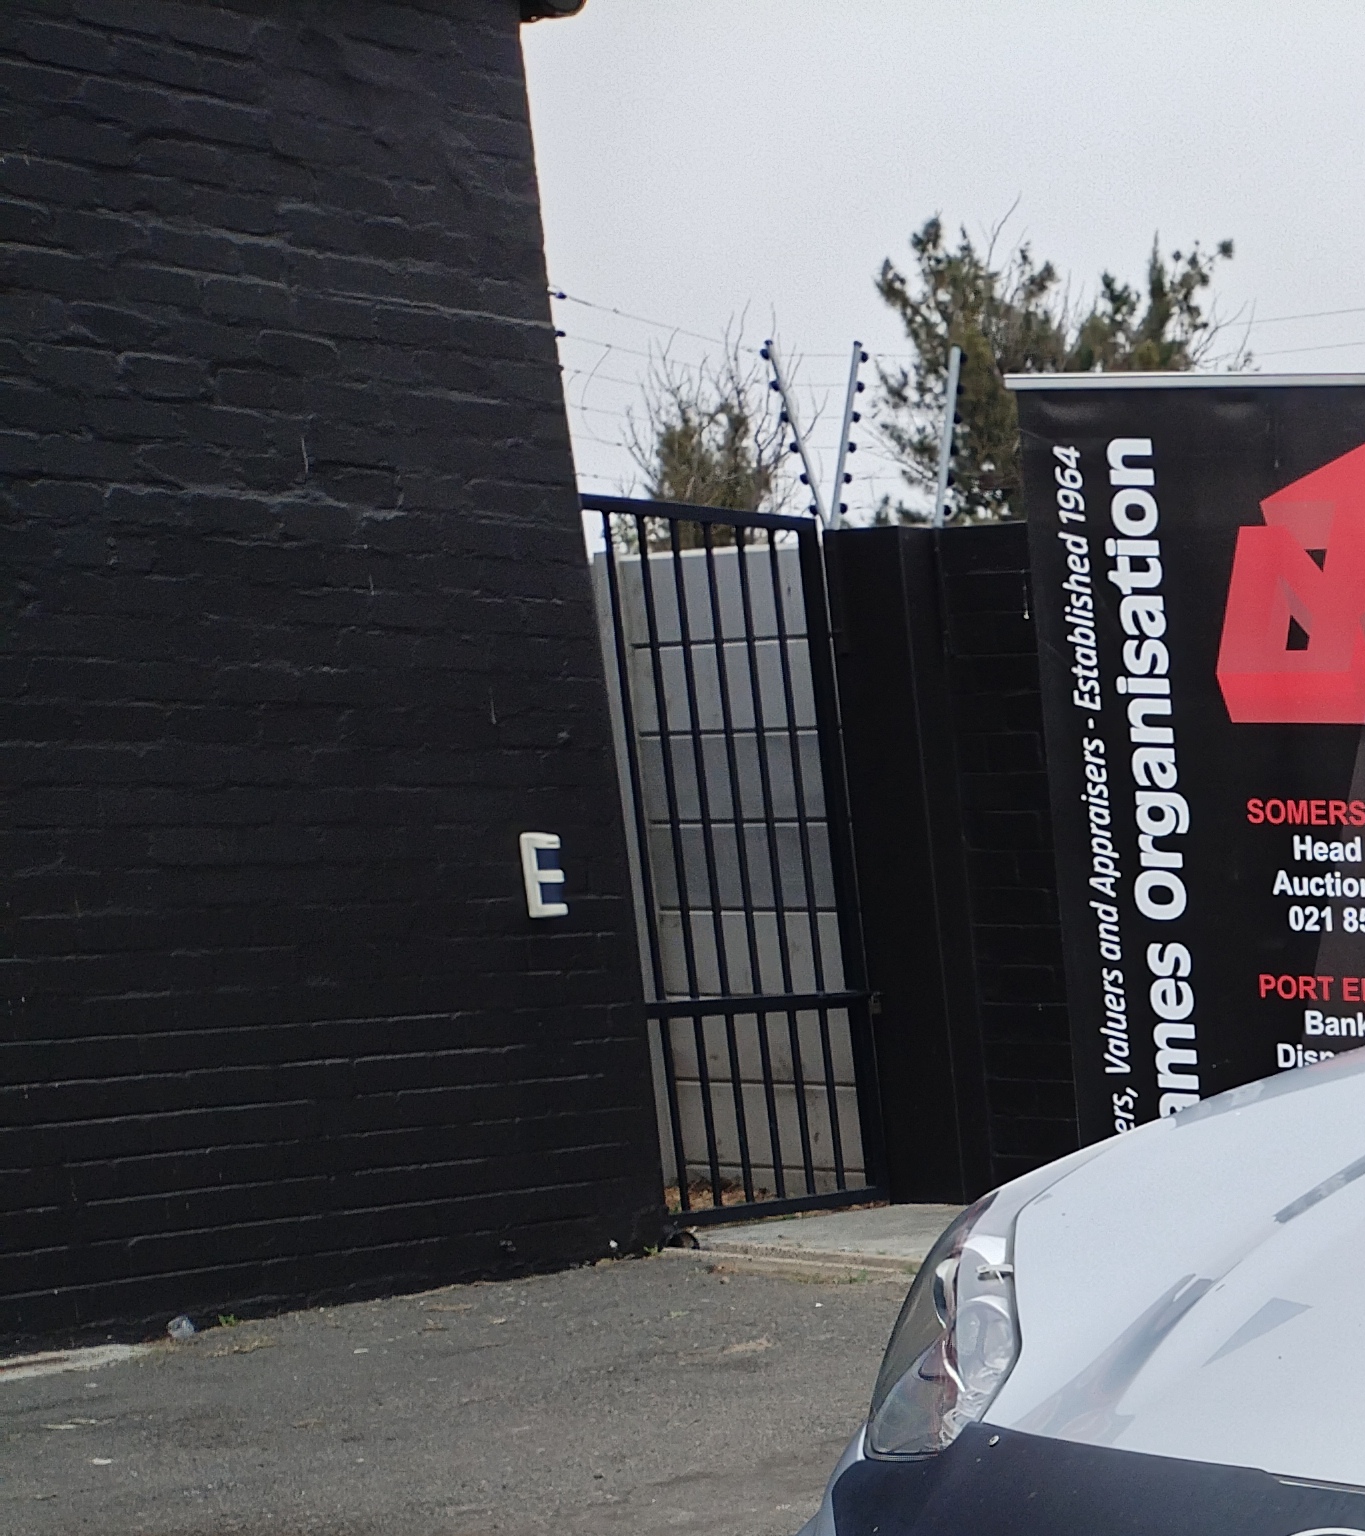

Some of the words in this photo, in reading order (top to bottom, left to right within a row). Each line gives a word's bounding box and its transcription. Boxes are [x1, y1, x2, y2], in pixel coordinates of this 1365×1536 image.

[1053, 446, 1086, 523] 1964
[1058, 532, 1101, 710] Established
[1105, 438, 1190, 920] Organisation
[1081, 737, 1121, 897] Appraisers
[1292, 834, 1362, 862] Head
[519, 831, 569, 918] E
[1089, 901, 1121, 961] and
[1288, 905, 1333, 932] 021
[1100, 968, 1131, 1073] Valuers
[1258, 974, 1334, 1001] PORT
[1147, 942, 1200, 1118] ames
[1112, 1087, 1138, 1134] ers,
